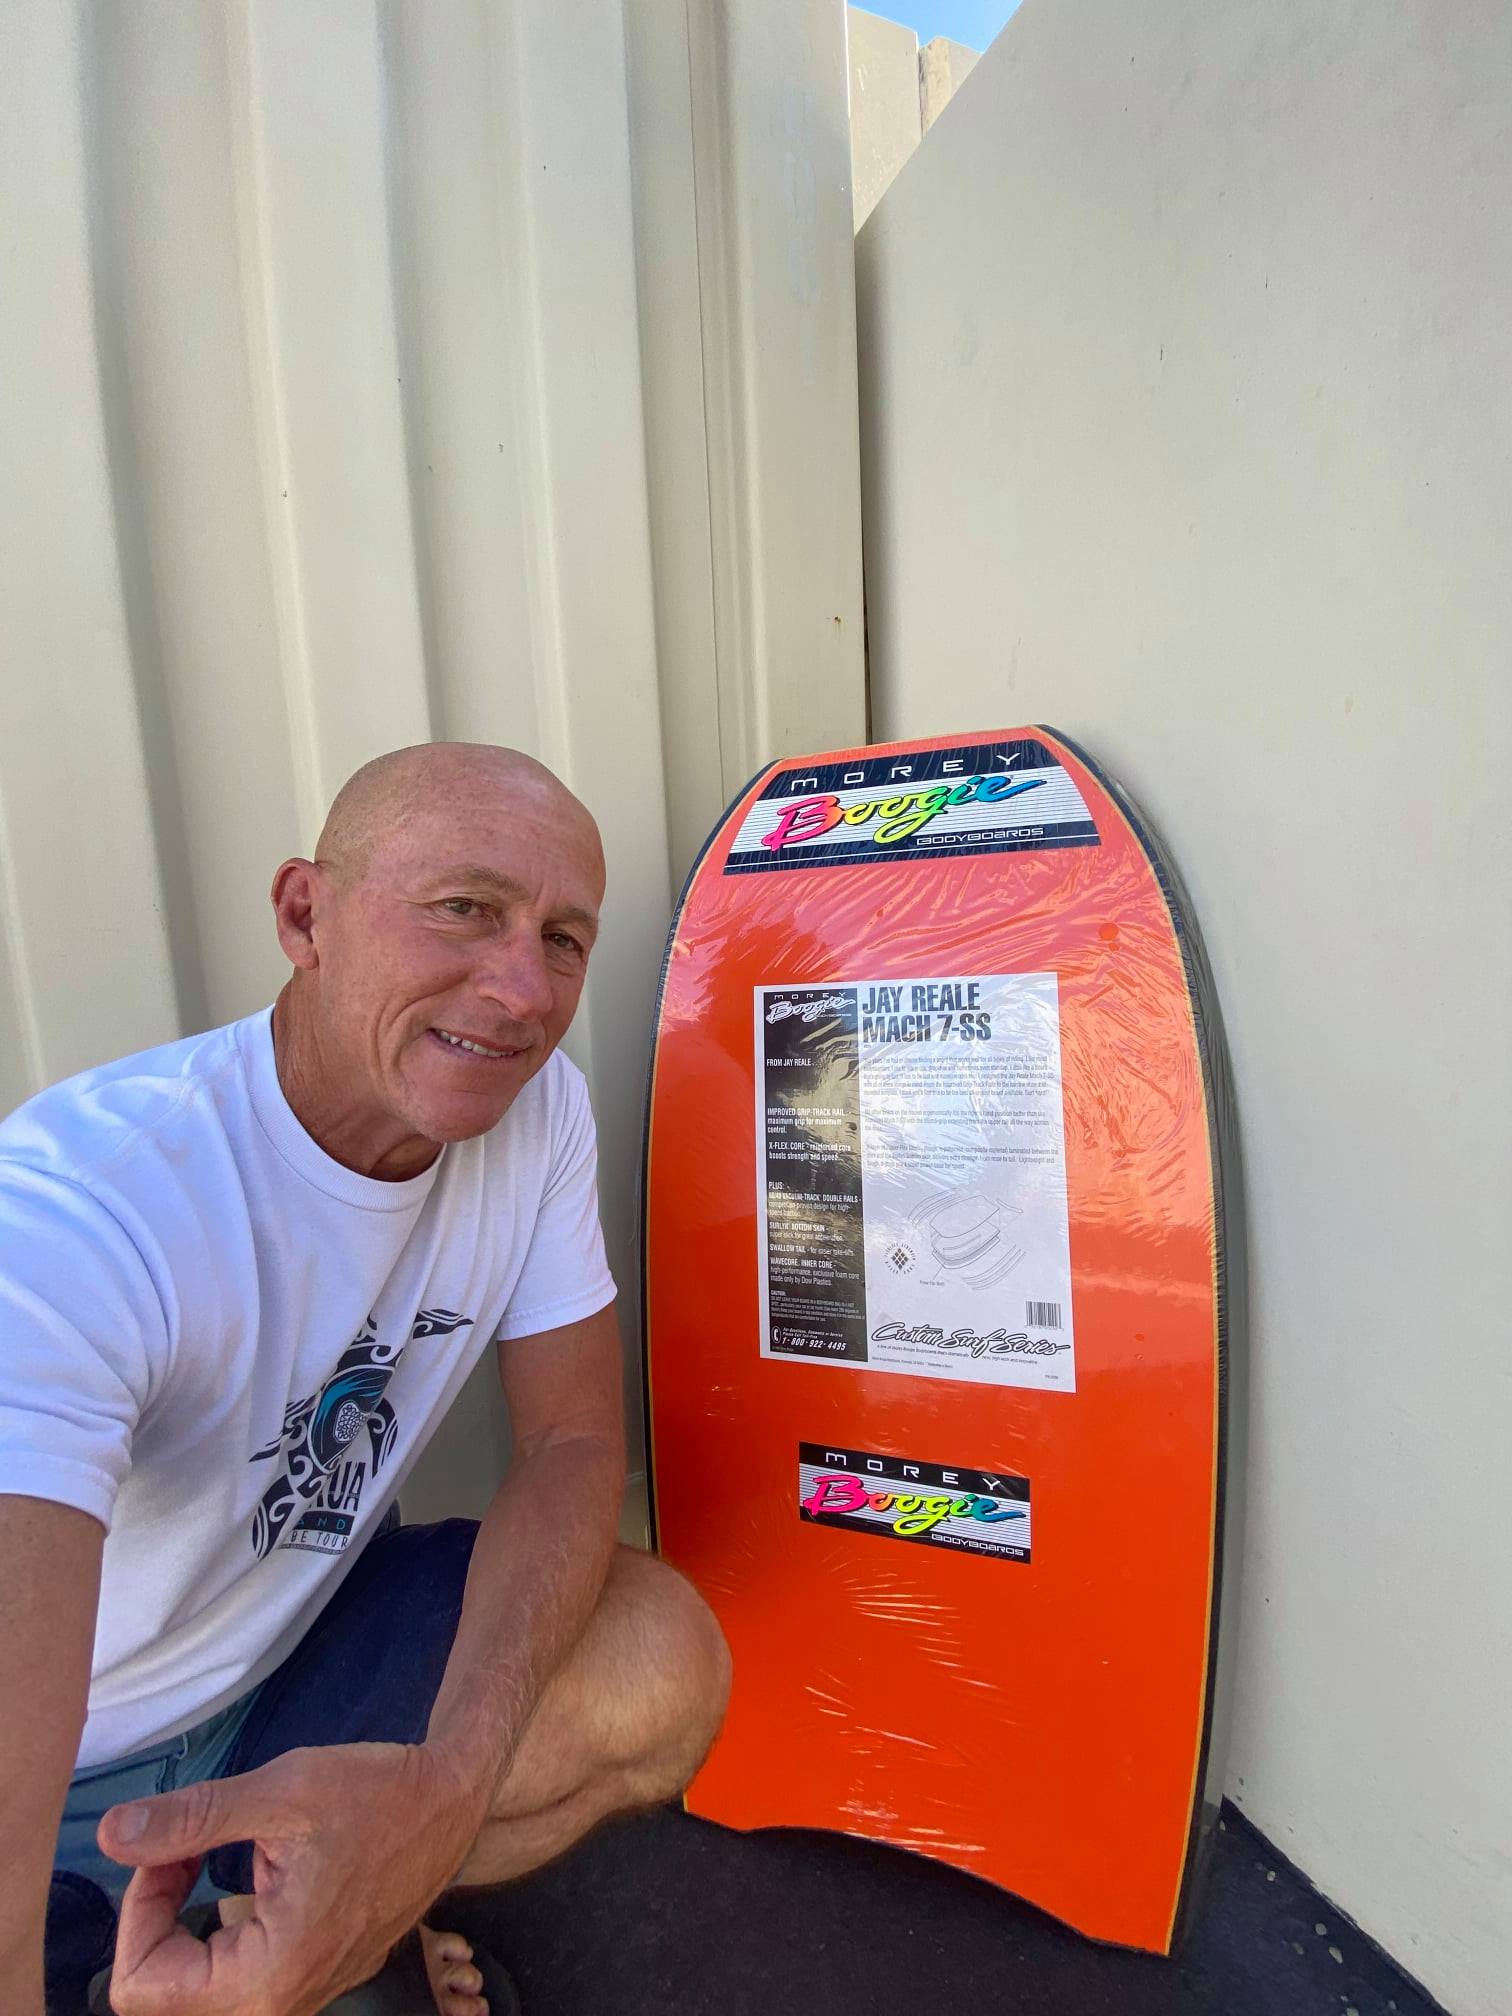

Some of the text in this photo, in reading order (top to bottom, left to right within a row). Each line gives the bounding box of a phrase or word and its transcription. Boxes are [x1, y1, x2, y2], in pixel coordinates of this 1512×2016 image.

[791, 752, 1021, 791] MOREY
[761, 775, 1047, 854] Boogie
[916, 827, 1044, 846] BODYBOARDS
[774, 991, 846, 1000] MOREY
[862, 983, 981, 1014] JAY REALE
[765, 996, 856, 1024] Boogie
[863, 1012, 992, 1043] MACH 7-SS
[766, 1059, 783, 1067] FROM
[783, 1059, 793, 1067] JAY
[767, 1107, 796, 1116] IMPROVED
[797, 1107, 831, 1116] GRIP-TRACK
[790, 1142, 805, 1150] CORE
[768, 1181, 784, 1190] PLUS:
[822, 1194, 842, 1203] DOUBLE
[843, 1195, 858, 1203] RAILS
[871, 1321, 1071, 1359] Custom Surf Series
[825, 1452, 1001, 1491] MOREY
[802, 1474, 1027, 1535] Boogie
[931, 1533, 1024, 1556] BODYBOARDS
